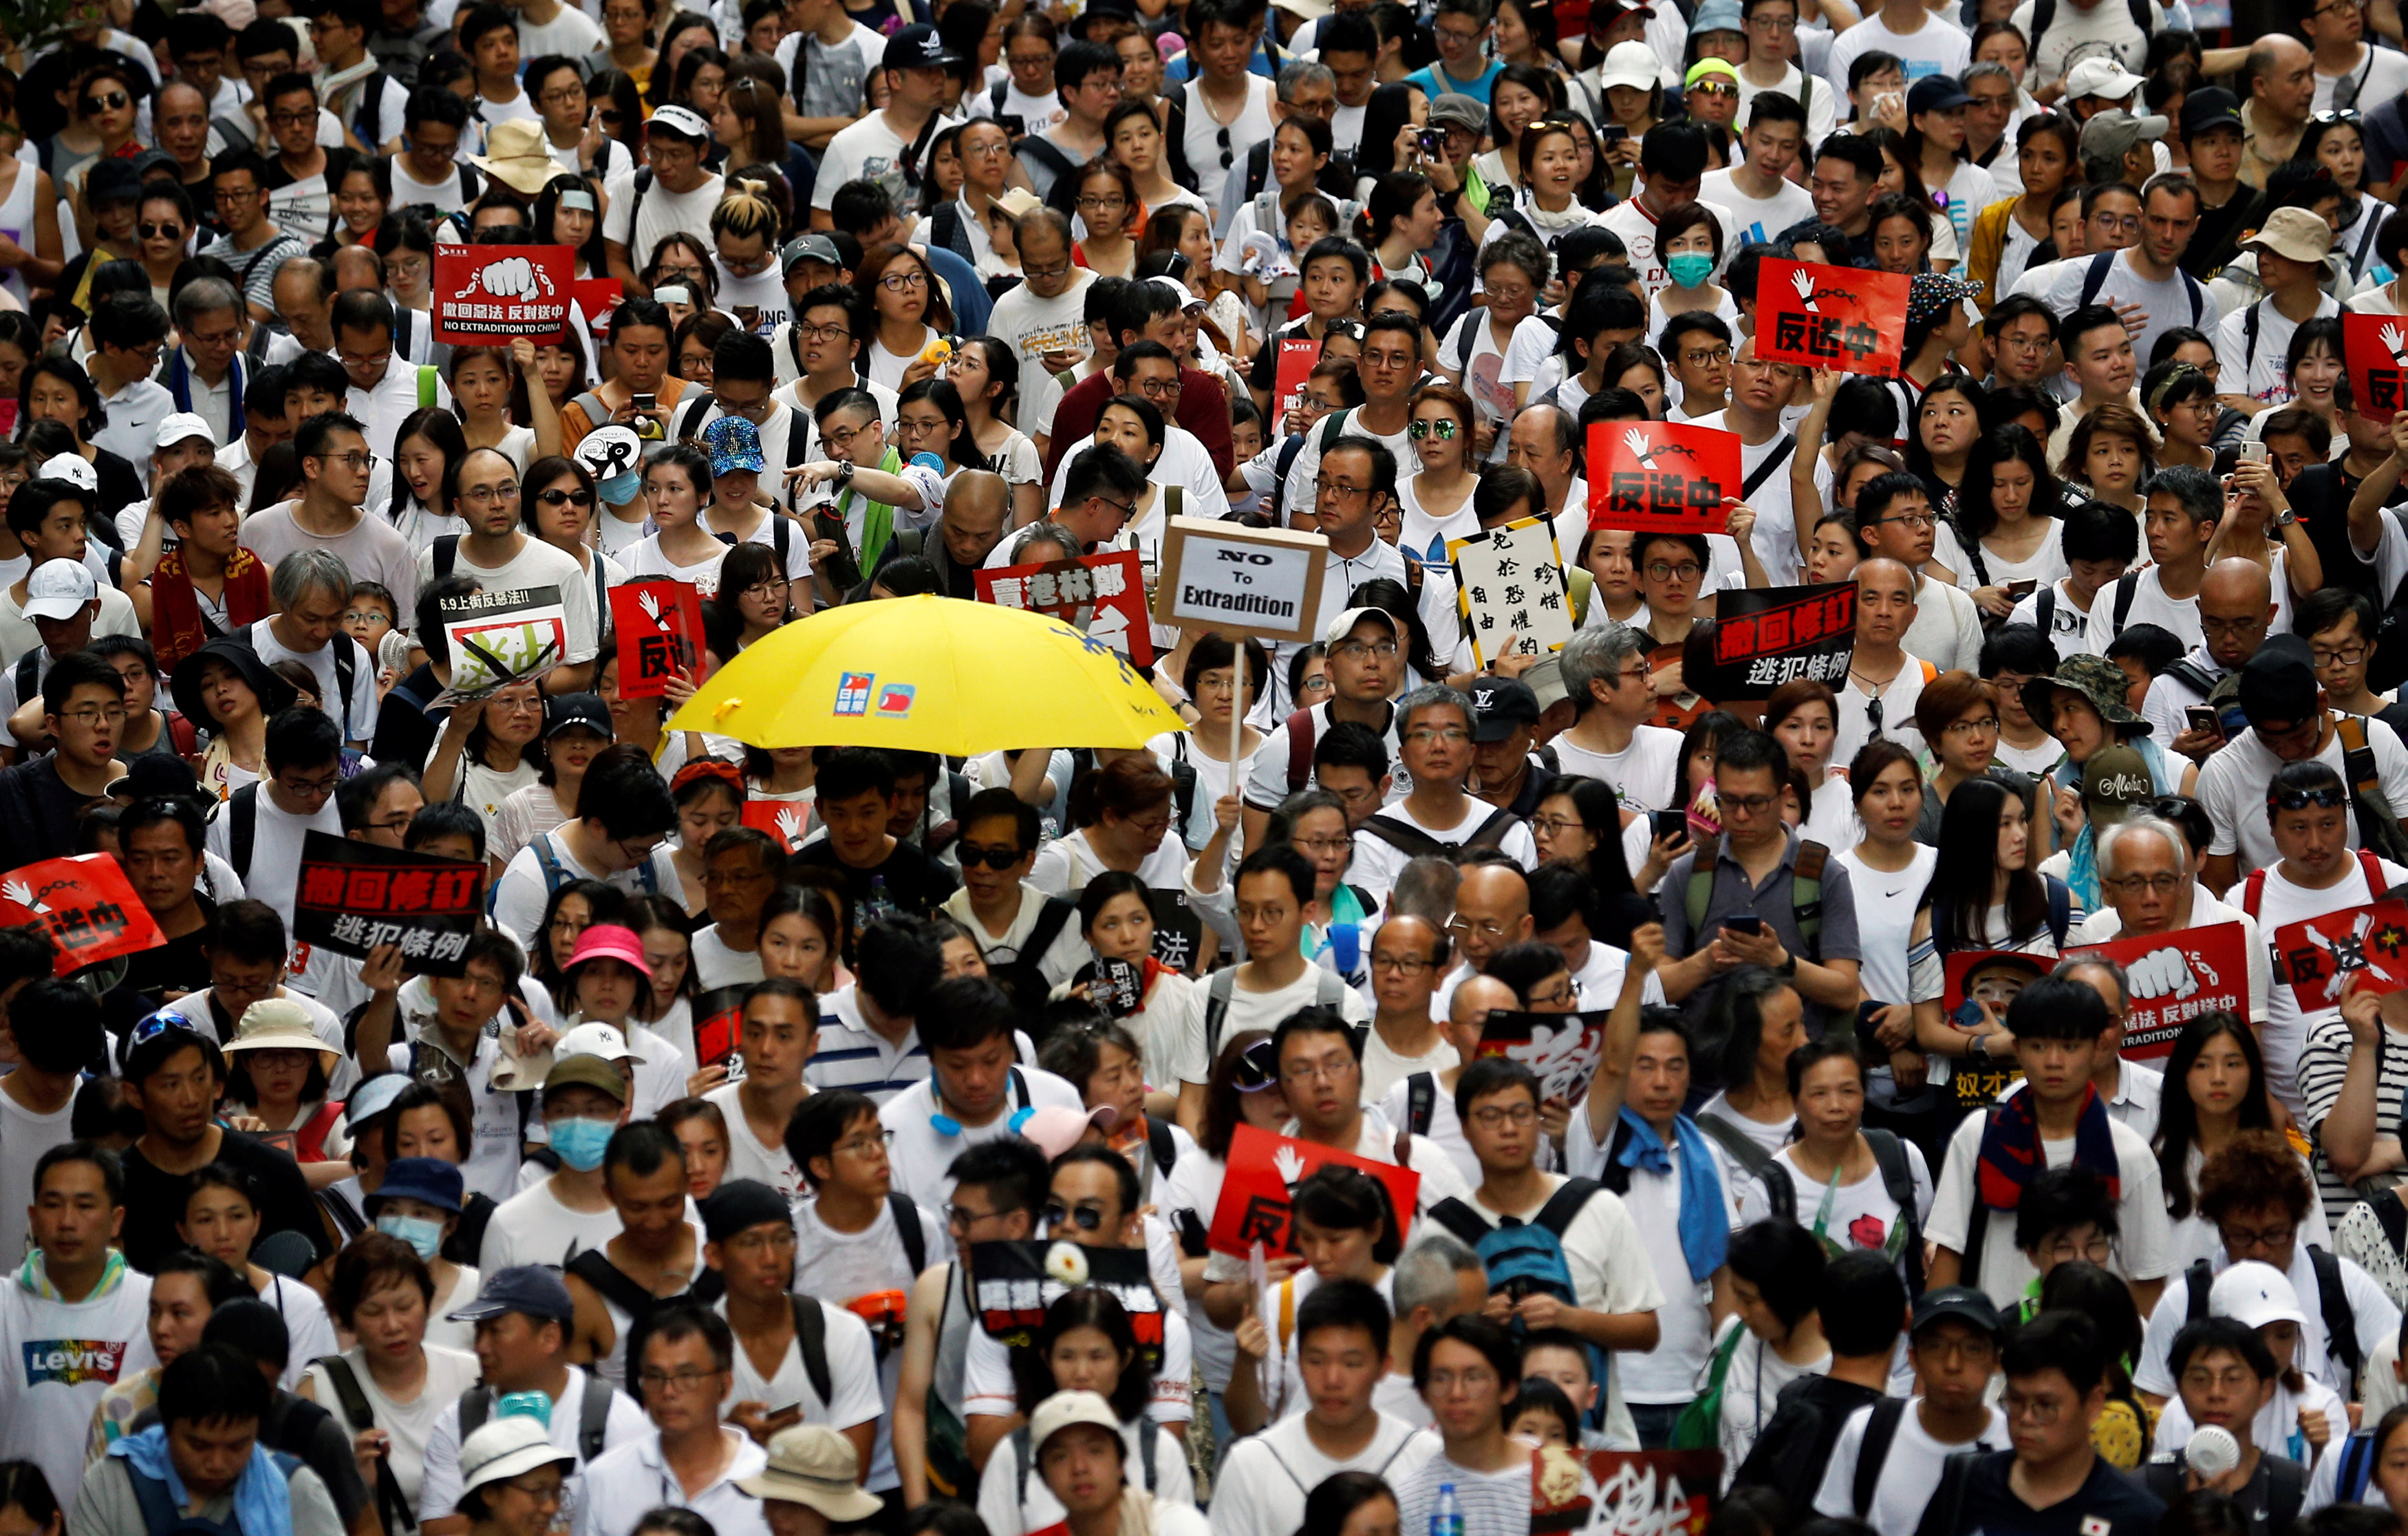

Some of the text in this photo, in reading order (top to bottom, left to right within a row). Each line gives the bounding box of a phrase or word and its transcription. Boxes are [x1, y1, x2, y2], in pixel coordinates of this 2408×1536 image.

[442, 302, 563, 321] 撤回惡法 反對送中
[444, 321, 561, 333] NO EXTRADITION TO CHINA
[1776, 310, 1878, 361] 反送中
[2368, 369, 2408, 412] 反
[1610, 472, 1721, 516] 反送中
[1217, 549, 1273, 566] NO
[1232, 571, 1254, 585] To
[990, 562, 1126, 608] 賣港林鄭
[1183, 585, 1294, 617] Extradition
[1493, 531, 1538, 655] 免於恐懼的
[1534, 562, 1561, 610] 珍惜
[1470, 586, 1494, 630] 自由
[1721, 590, 1853, 661] 撤回修訂
[1745, 650, 1853, 685] 逃犯條例
[2099, 773, 2149, 800] Aloha
[303, 866, 479, 911] 撤回修訂
[330, 913, 471, 962] 逃犯條例
[1110, 962, 1136, 1008] 反送中
[2162, 994, 2237, 1025] 反對送中
